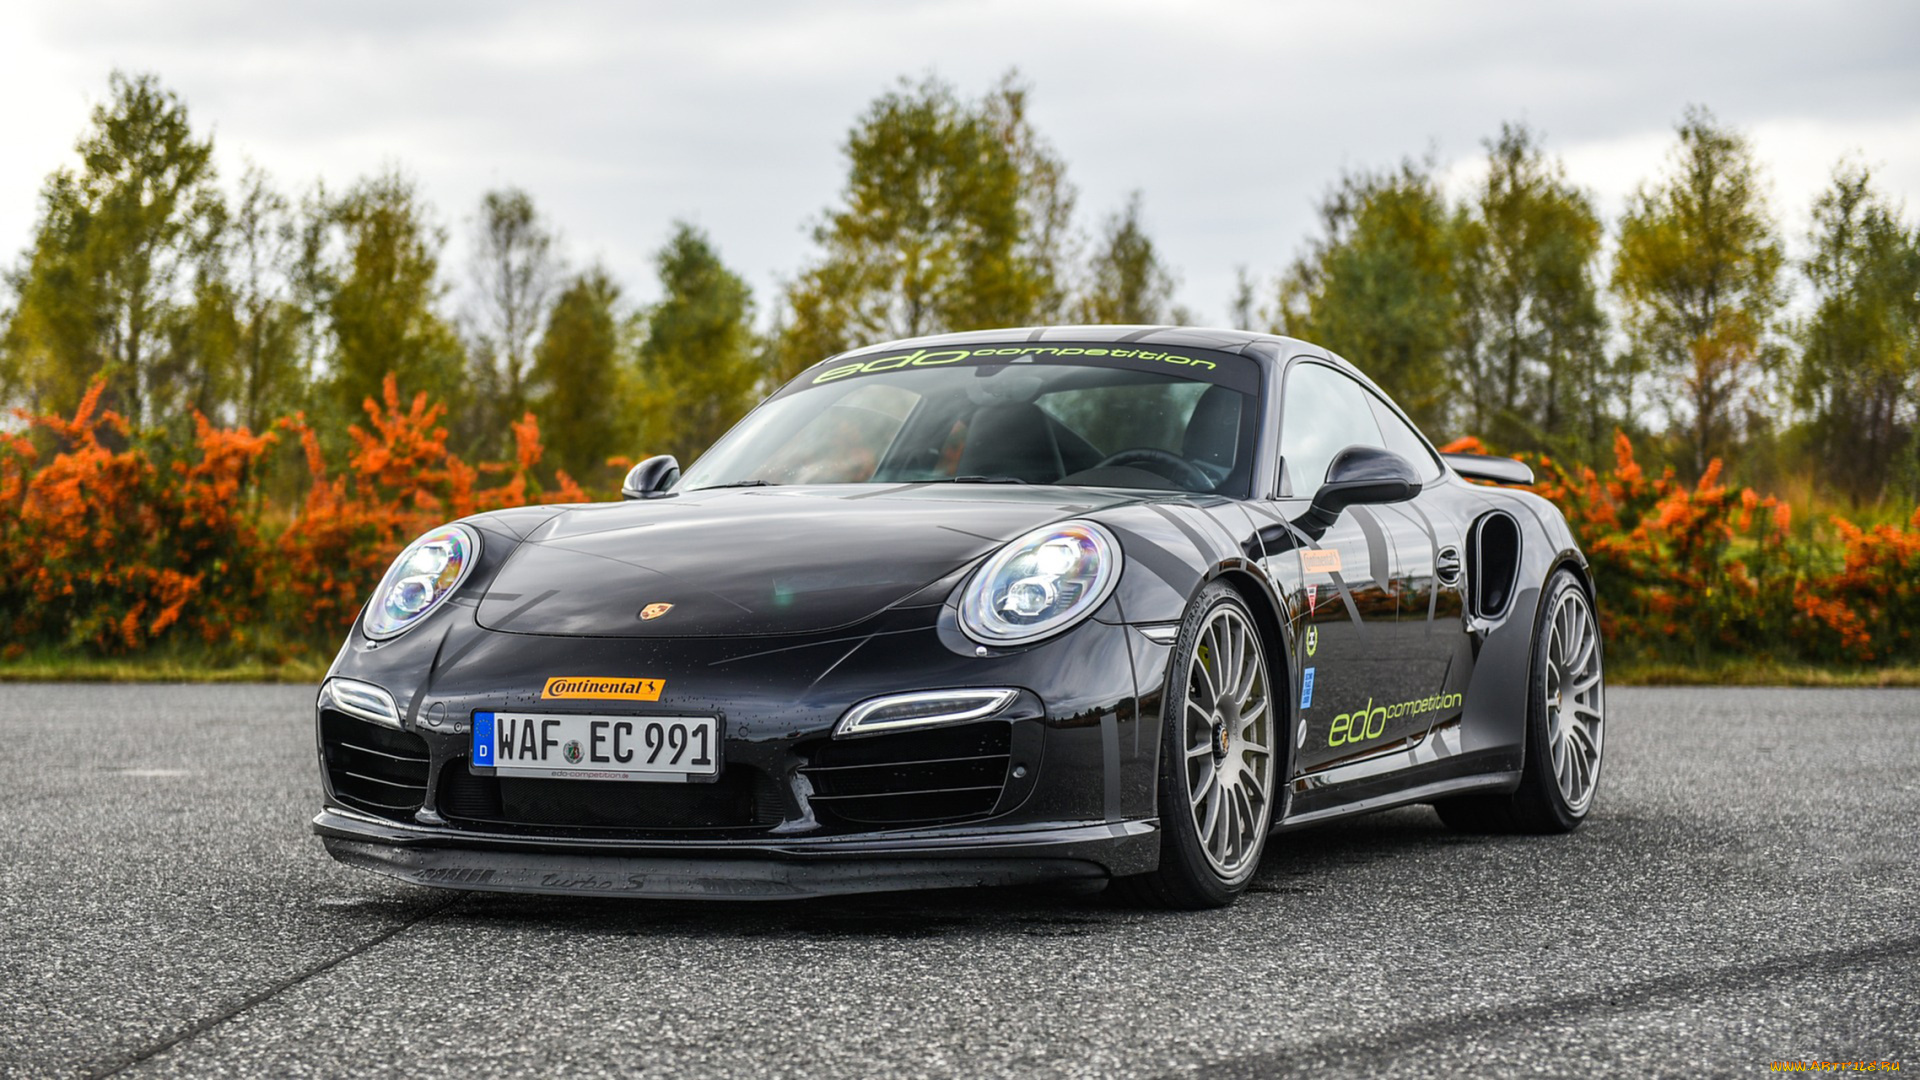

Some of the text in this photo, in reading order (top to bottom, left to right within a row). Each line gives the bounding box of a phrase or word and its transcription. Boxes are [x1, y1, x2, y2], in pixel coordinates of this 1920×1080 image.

[812, 347, 1217, 384] edo competition
[548, 679, 641, 697] Continental
[1328, 692, 1462, 747] edo competition
[479, 745, 488, 757] D
[497, 718, 711, 765] WAF EC 991
[541, 873, 612, 889] turbo
